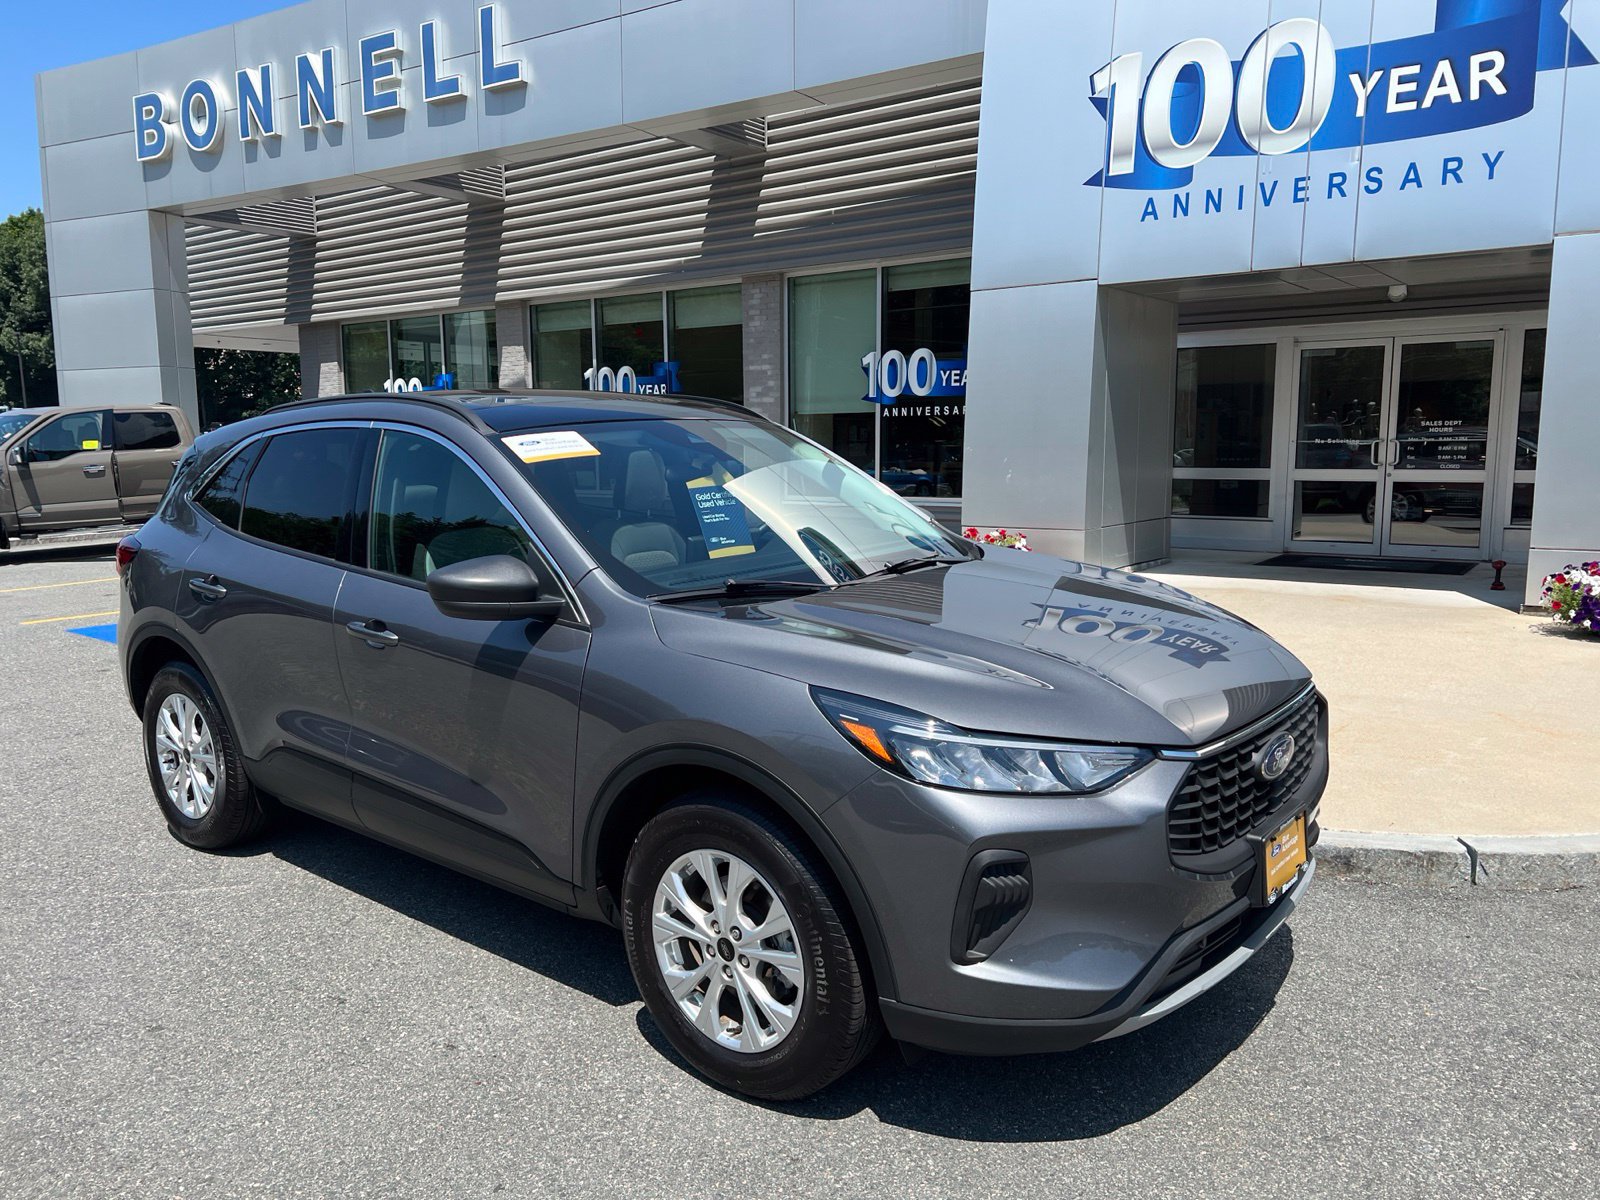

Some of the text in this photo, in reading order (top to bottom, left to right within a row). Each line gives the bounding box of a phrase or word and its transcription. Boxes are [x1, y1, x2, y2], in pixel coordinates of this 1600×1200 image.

[133, 4, 524, 162] BONNELL
[1090, 18, 1508, 176] 100 YEAR
[1140, 150, 1505, 222] ANNIVERSARY
[583, 366, 637, 393] 100
[861, 347, 967, 397] 100 YEA
[695, 492, 711, 501] Gold
[697, 499, 737, 509] Used Vehicle
